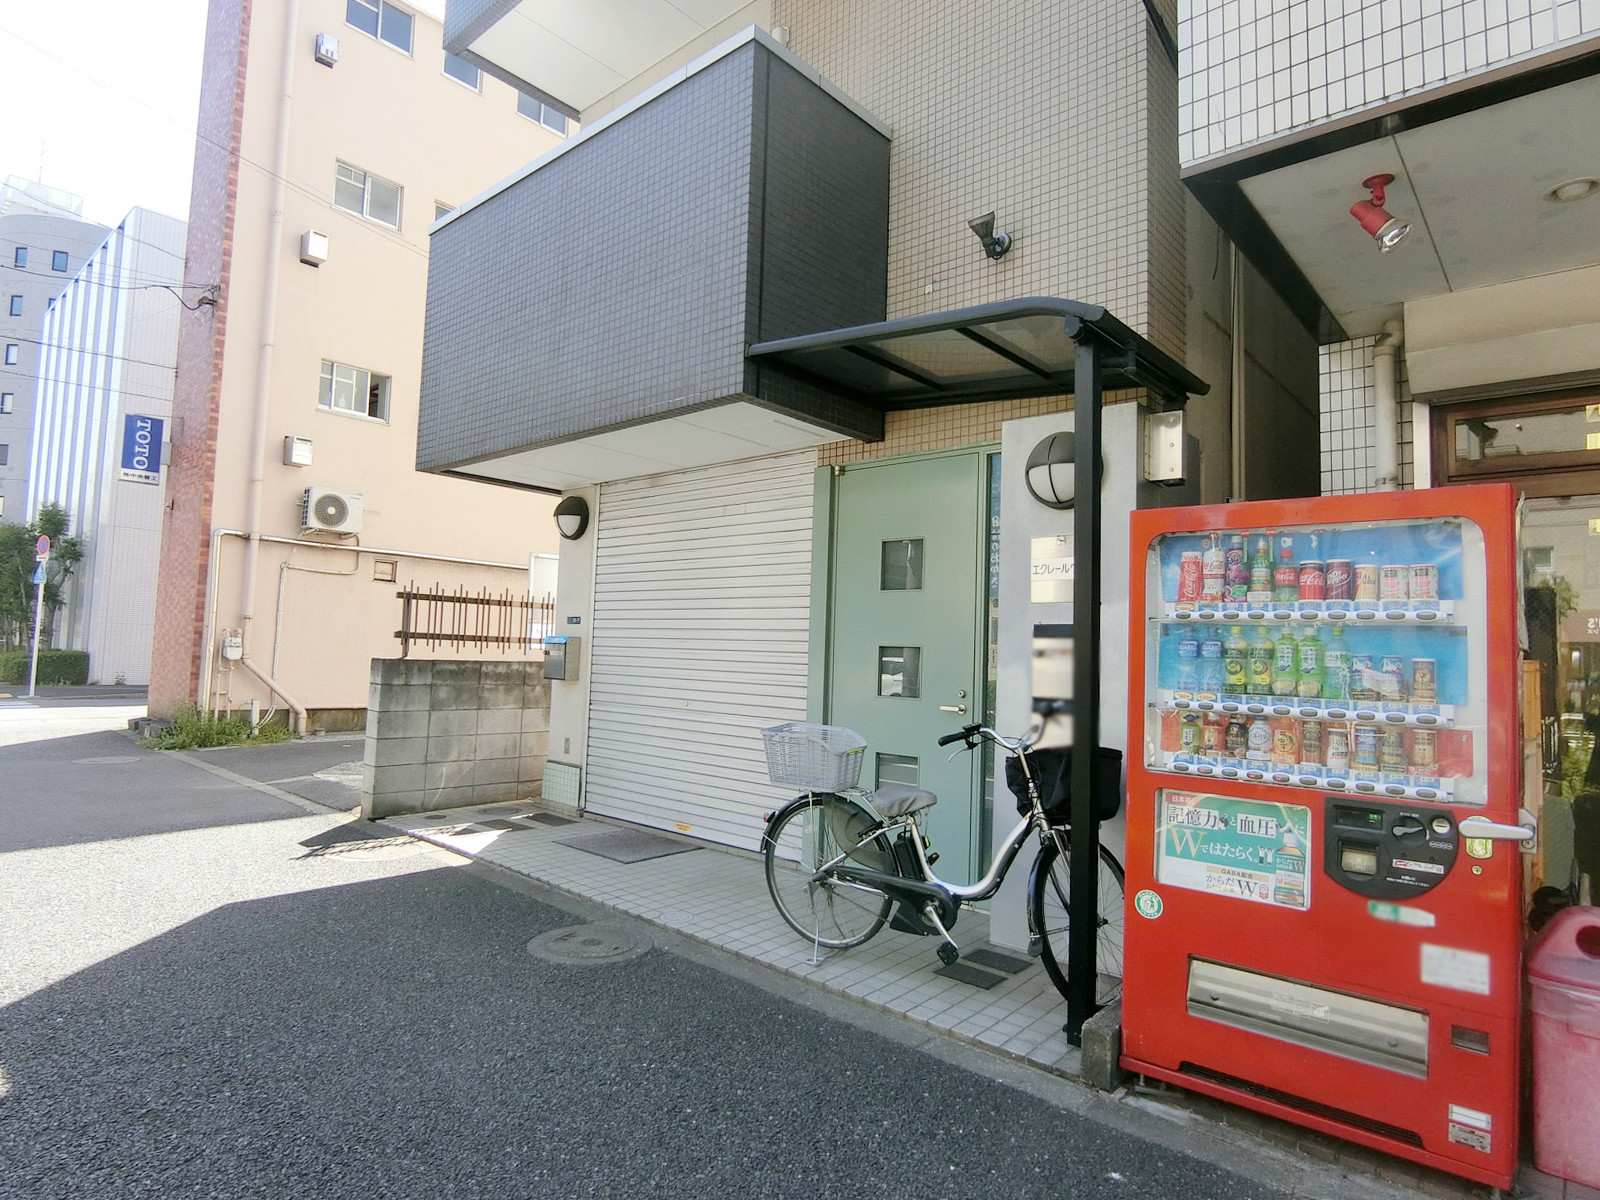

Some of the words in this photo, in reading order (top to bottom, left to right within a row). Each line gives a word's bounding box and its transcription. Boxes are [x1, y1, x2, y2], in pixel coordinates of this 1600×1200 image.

[133, 419, 152, 470] TOTO
[1184, 563, 1196, 597] Coca-Cola
[1222, 868, 1253, 879] GABA配合
